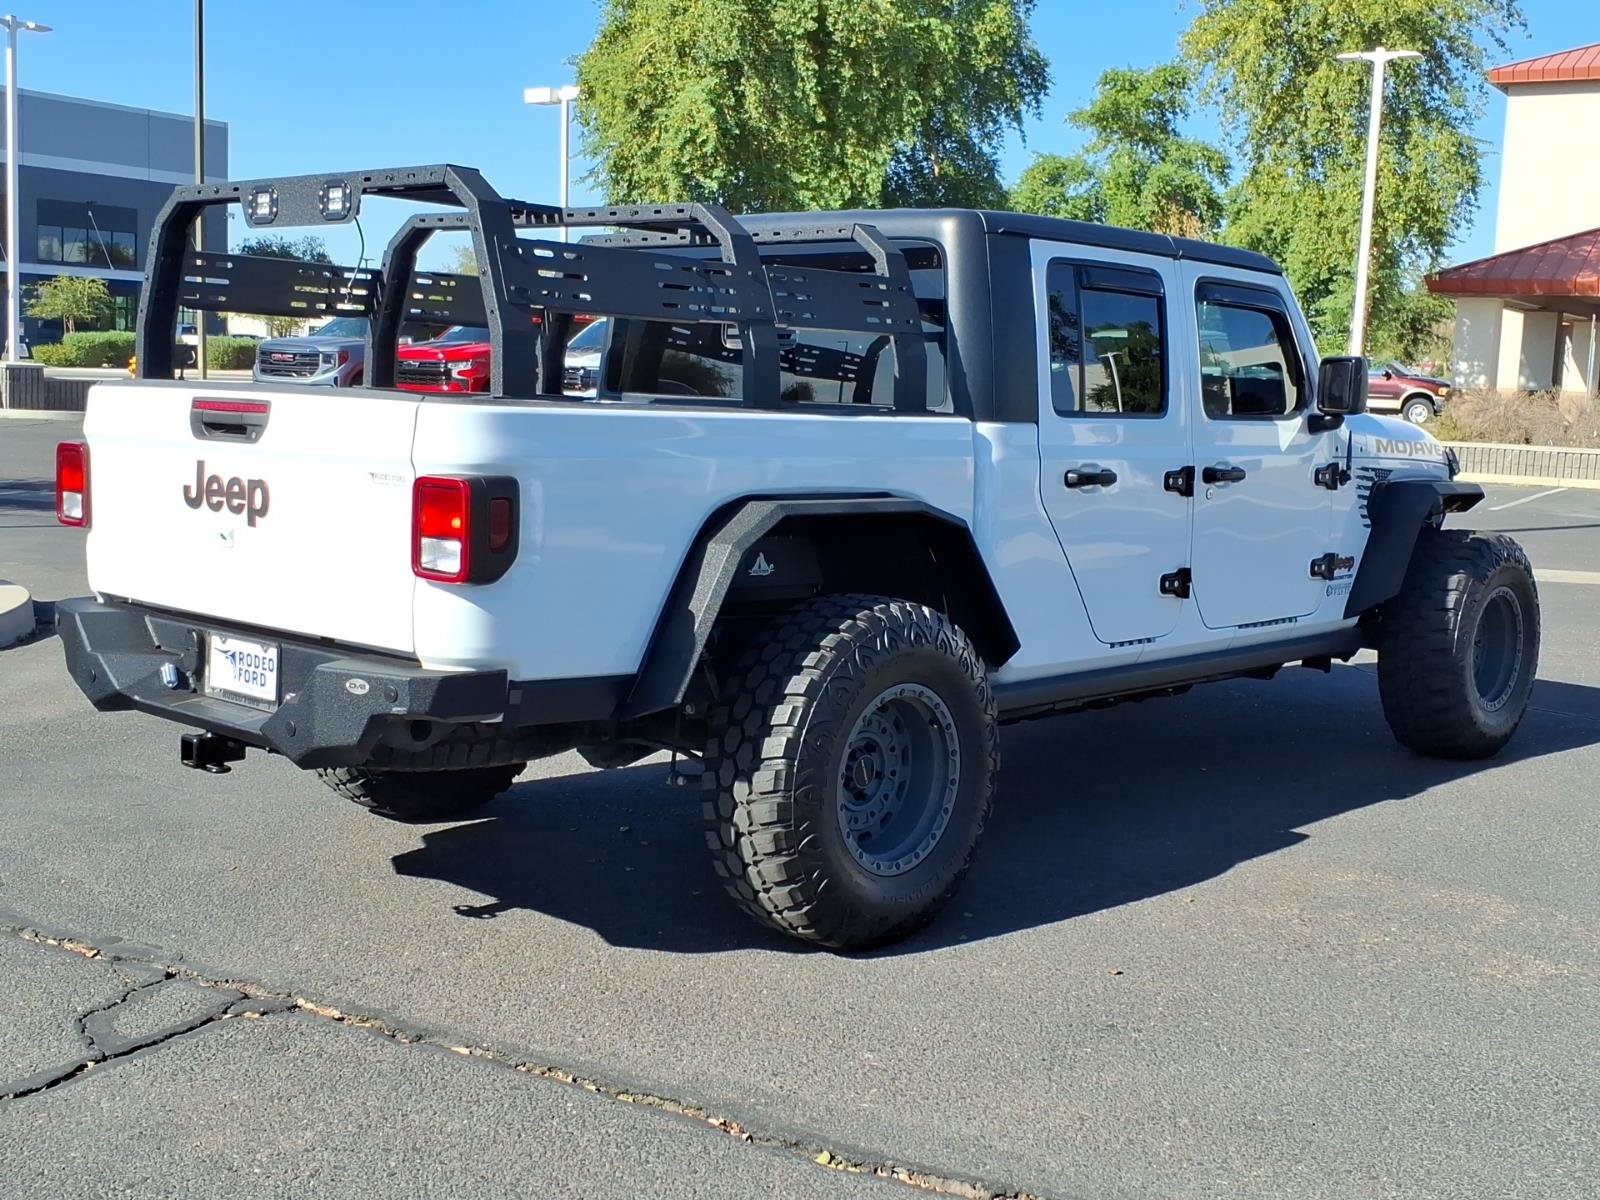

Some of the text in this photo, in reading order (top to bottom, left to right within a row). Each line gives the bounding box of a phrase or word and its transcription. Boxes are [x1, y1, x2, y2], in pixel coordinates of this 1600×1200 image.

[1375, 438, 1442, 457] MOJAVE
[183, 459, 270, 528] Jeep
[238, 651, 275, 673] RODEO
[238, 667, 267, 687] FORD
